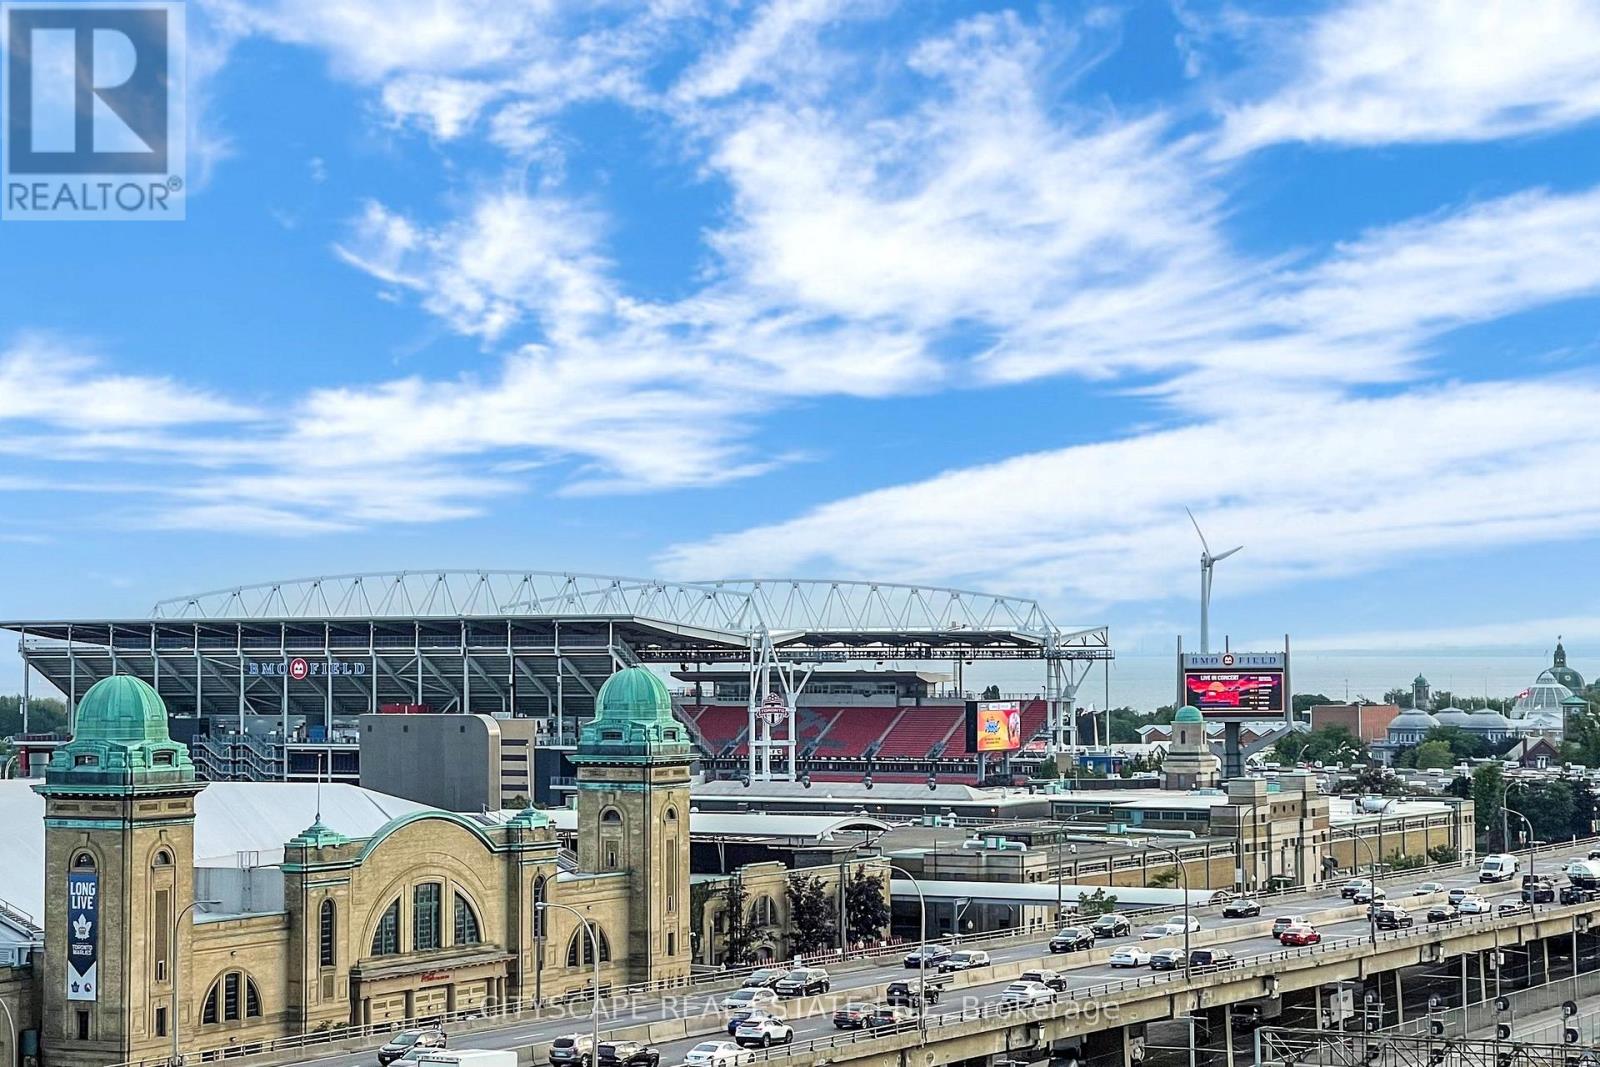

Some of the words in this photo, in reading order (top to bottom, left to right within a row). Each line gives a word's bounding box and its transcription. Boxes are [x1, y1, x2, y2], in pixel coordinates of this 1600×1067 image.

[1192, 656, 1218, 665] BMO
[1239, 656, 1276, 665] FIELD
[249, 663, 288, 674] BMO
[310, 663, 365, 674] FIELD
[70, 882, 95, 895] LONG
[72, 896, 93, 909] LIVE
